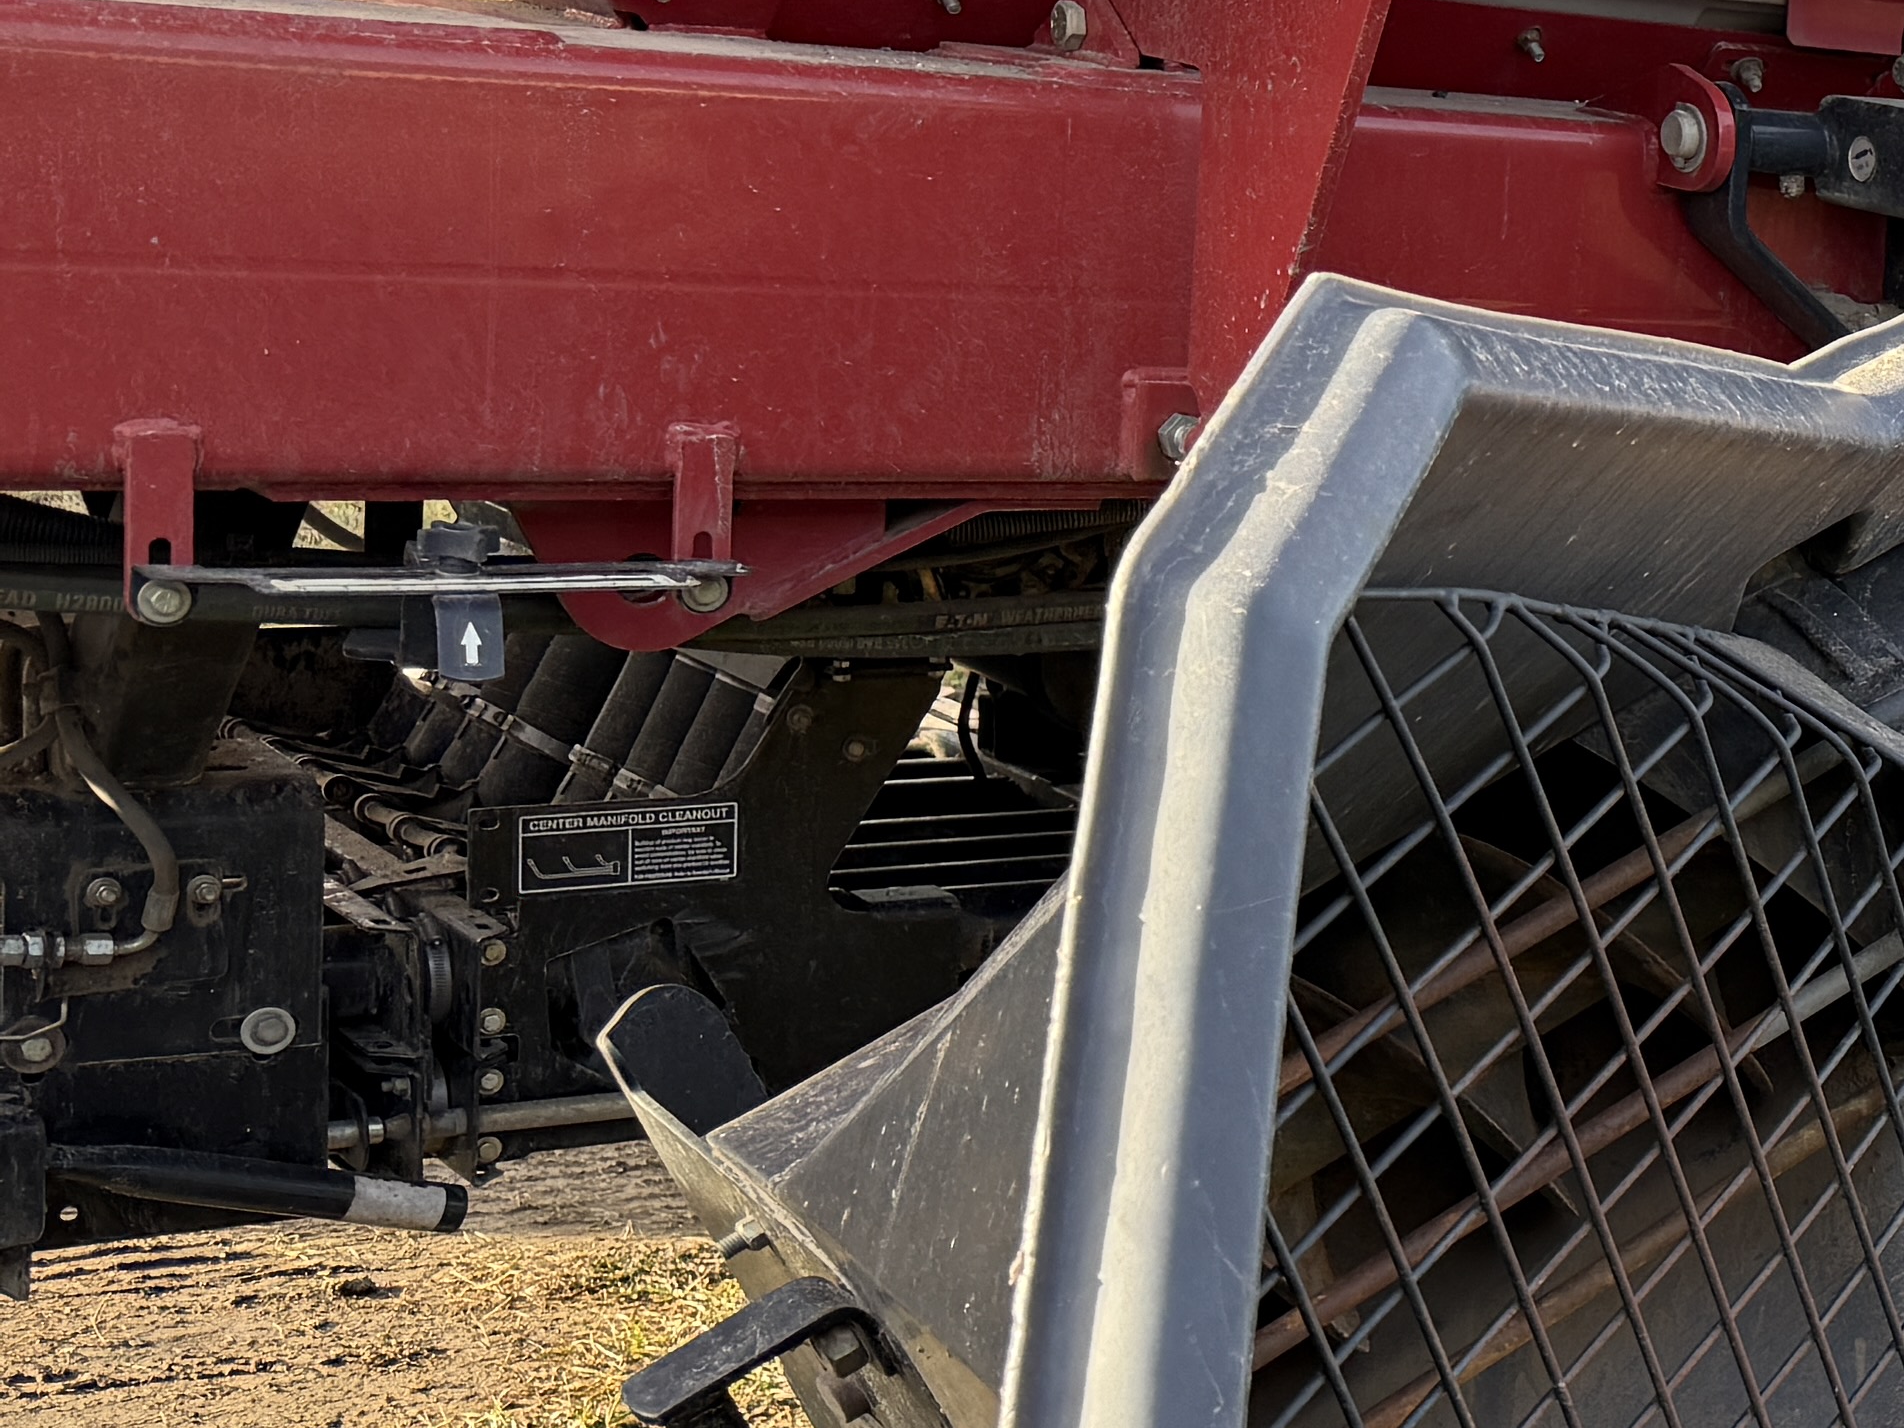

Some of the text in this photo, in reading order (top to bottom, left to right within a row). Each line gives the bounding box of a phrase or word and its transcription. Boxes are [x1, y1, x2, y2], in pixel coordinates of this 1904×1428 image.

[529, 807, 729, 832] CENTER MANIFOLD CLEANOUT
